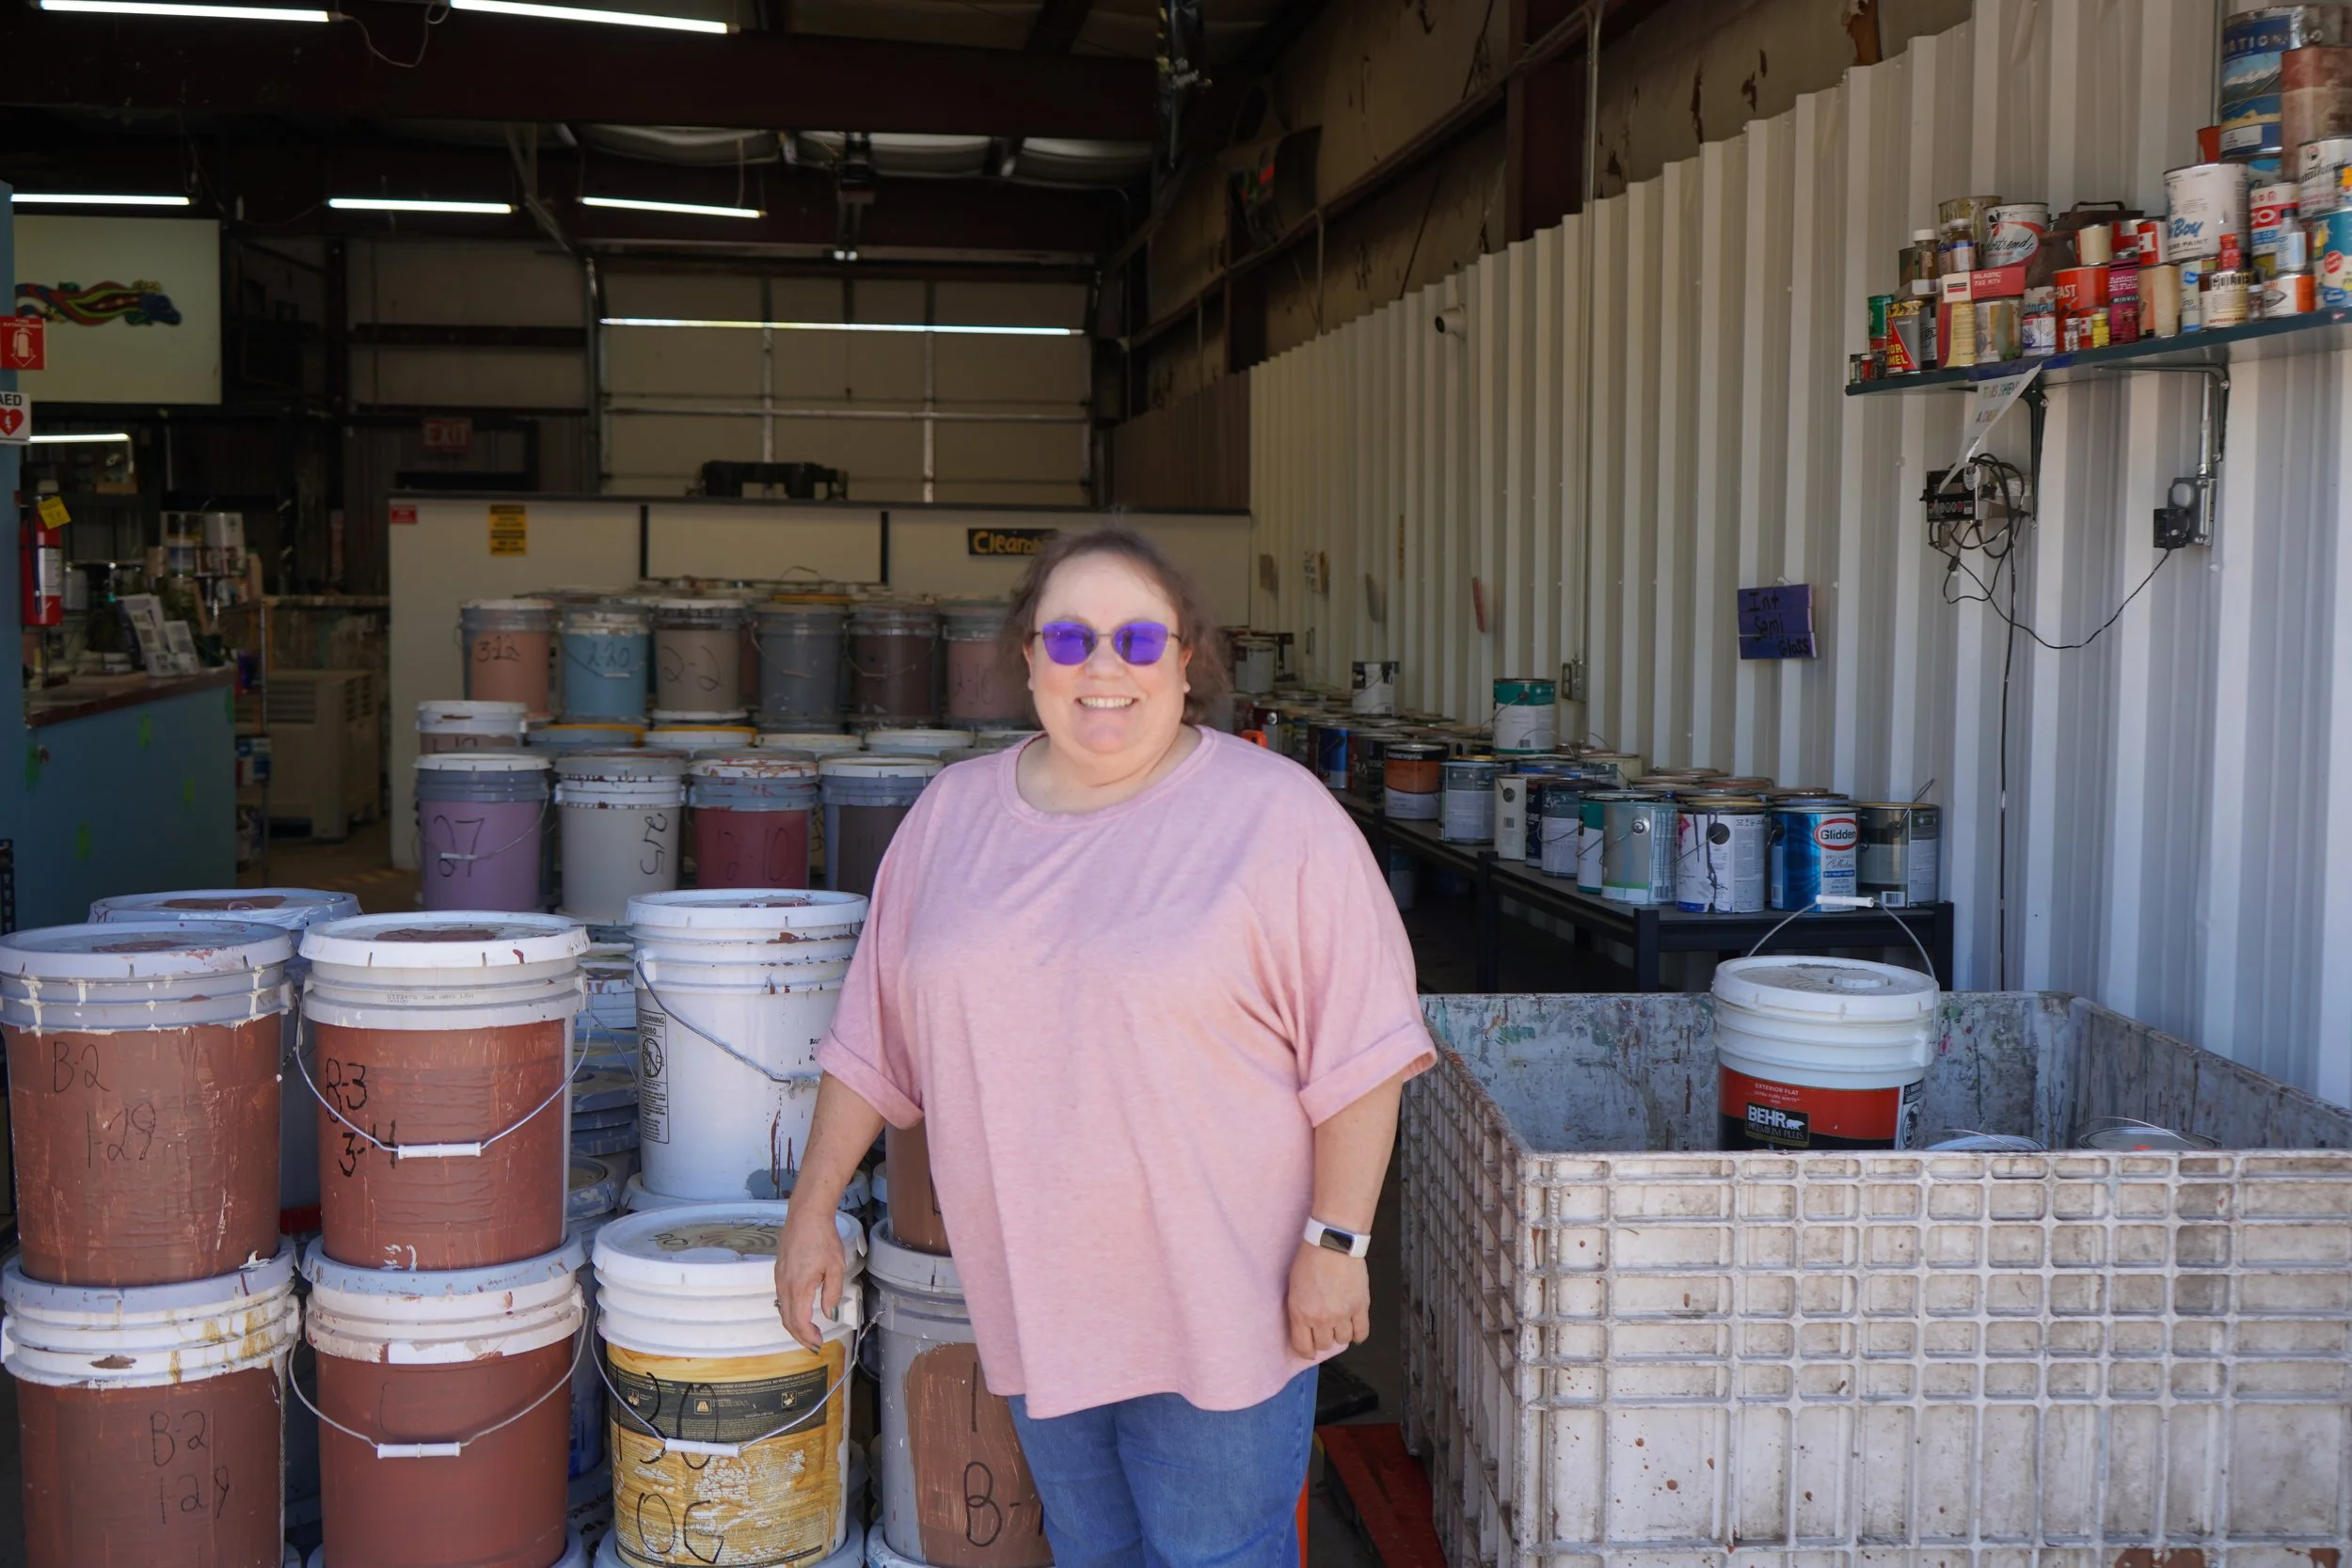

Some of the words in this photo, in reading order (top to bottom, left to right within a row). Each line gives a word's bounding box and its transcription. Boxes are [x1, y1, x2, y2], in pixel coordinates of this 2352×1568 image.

[2183, 238, 2209, 247] PAINT
[1755, 1082, 1784, 1094] EXTERIOR
[1784, 1087, 1800, 1096] FLAT
[1747, 1104, 1787, 1129] BEHR
